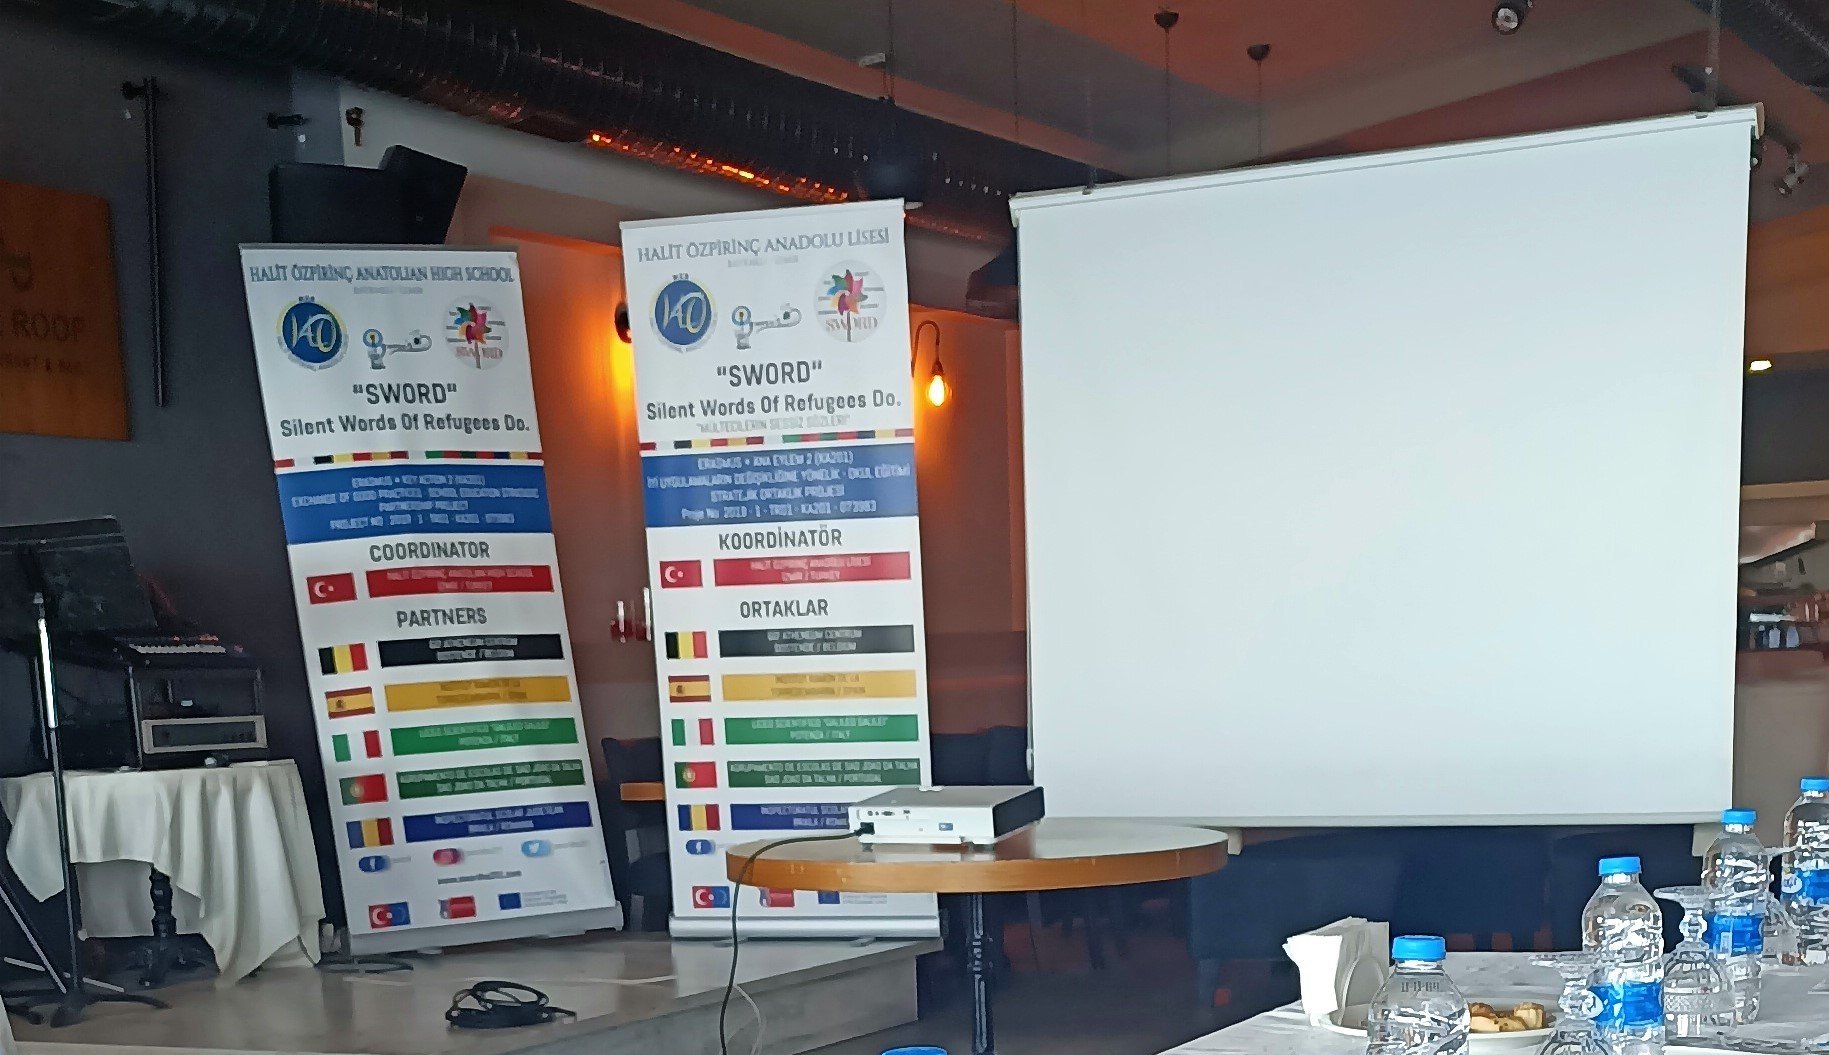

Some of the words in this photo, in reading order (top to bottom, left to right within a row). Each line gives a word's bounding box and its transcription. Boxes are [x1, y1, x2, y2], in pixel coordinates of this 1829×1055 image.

[764, 232, 843, 252] ANADOLU
[430, 266, 463, 281] HIGH
[465, 266, 515, 282] SCHOOL
[716, 359, 823, 387] "SWORD"
[352, 383, 457, 405] "SWORD"
[647, 402, 695, 420] Silent
[699, 397, 755, 417] Words
[760, 395, 779, 413] Of
[784, 393, 866, 415] Refugees
[872, 389, 902, 408] Do.
[280, 418, 335, 437] Silent
[339, 414, 397, 432] Words
[401, 413, 419, 430] Of
[423, 413, 500, 435] Refugees
[504, 414, 531, 431] Do.
[718, 524, 843, 551] KOORDİNATÖR
[369, 541, 490, 563] COORDINATOR
[396, 607, 488, 629] PARTNERS
[740, 599, 829, 619] ORTAKLAR
